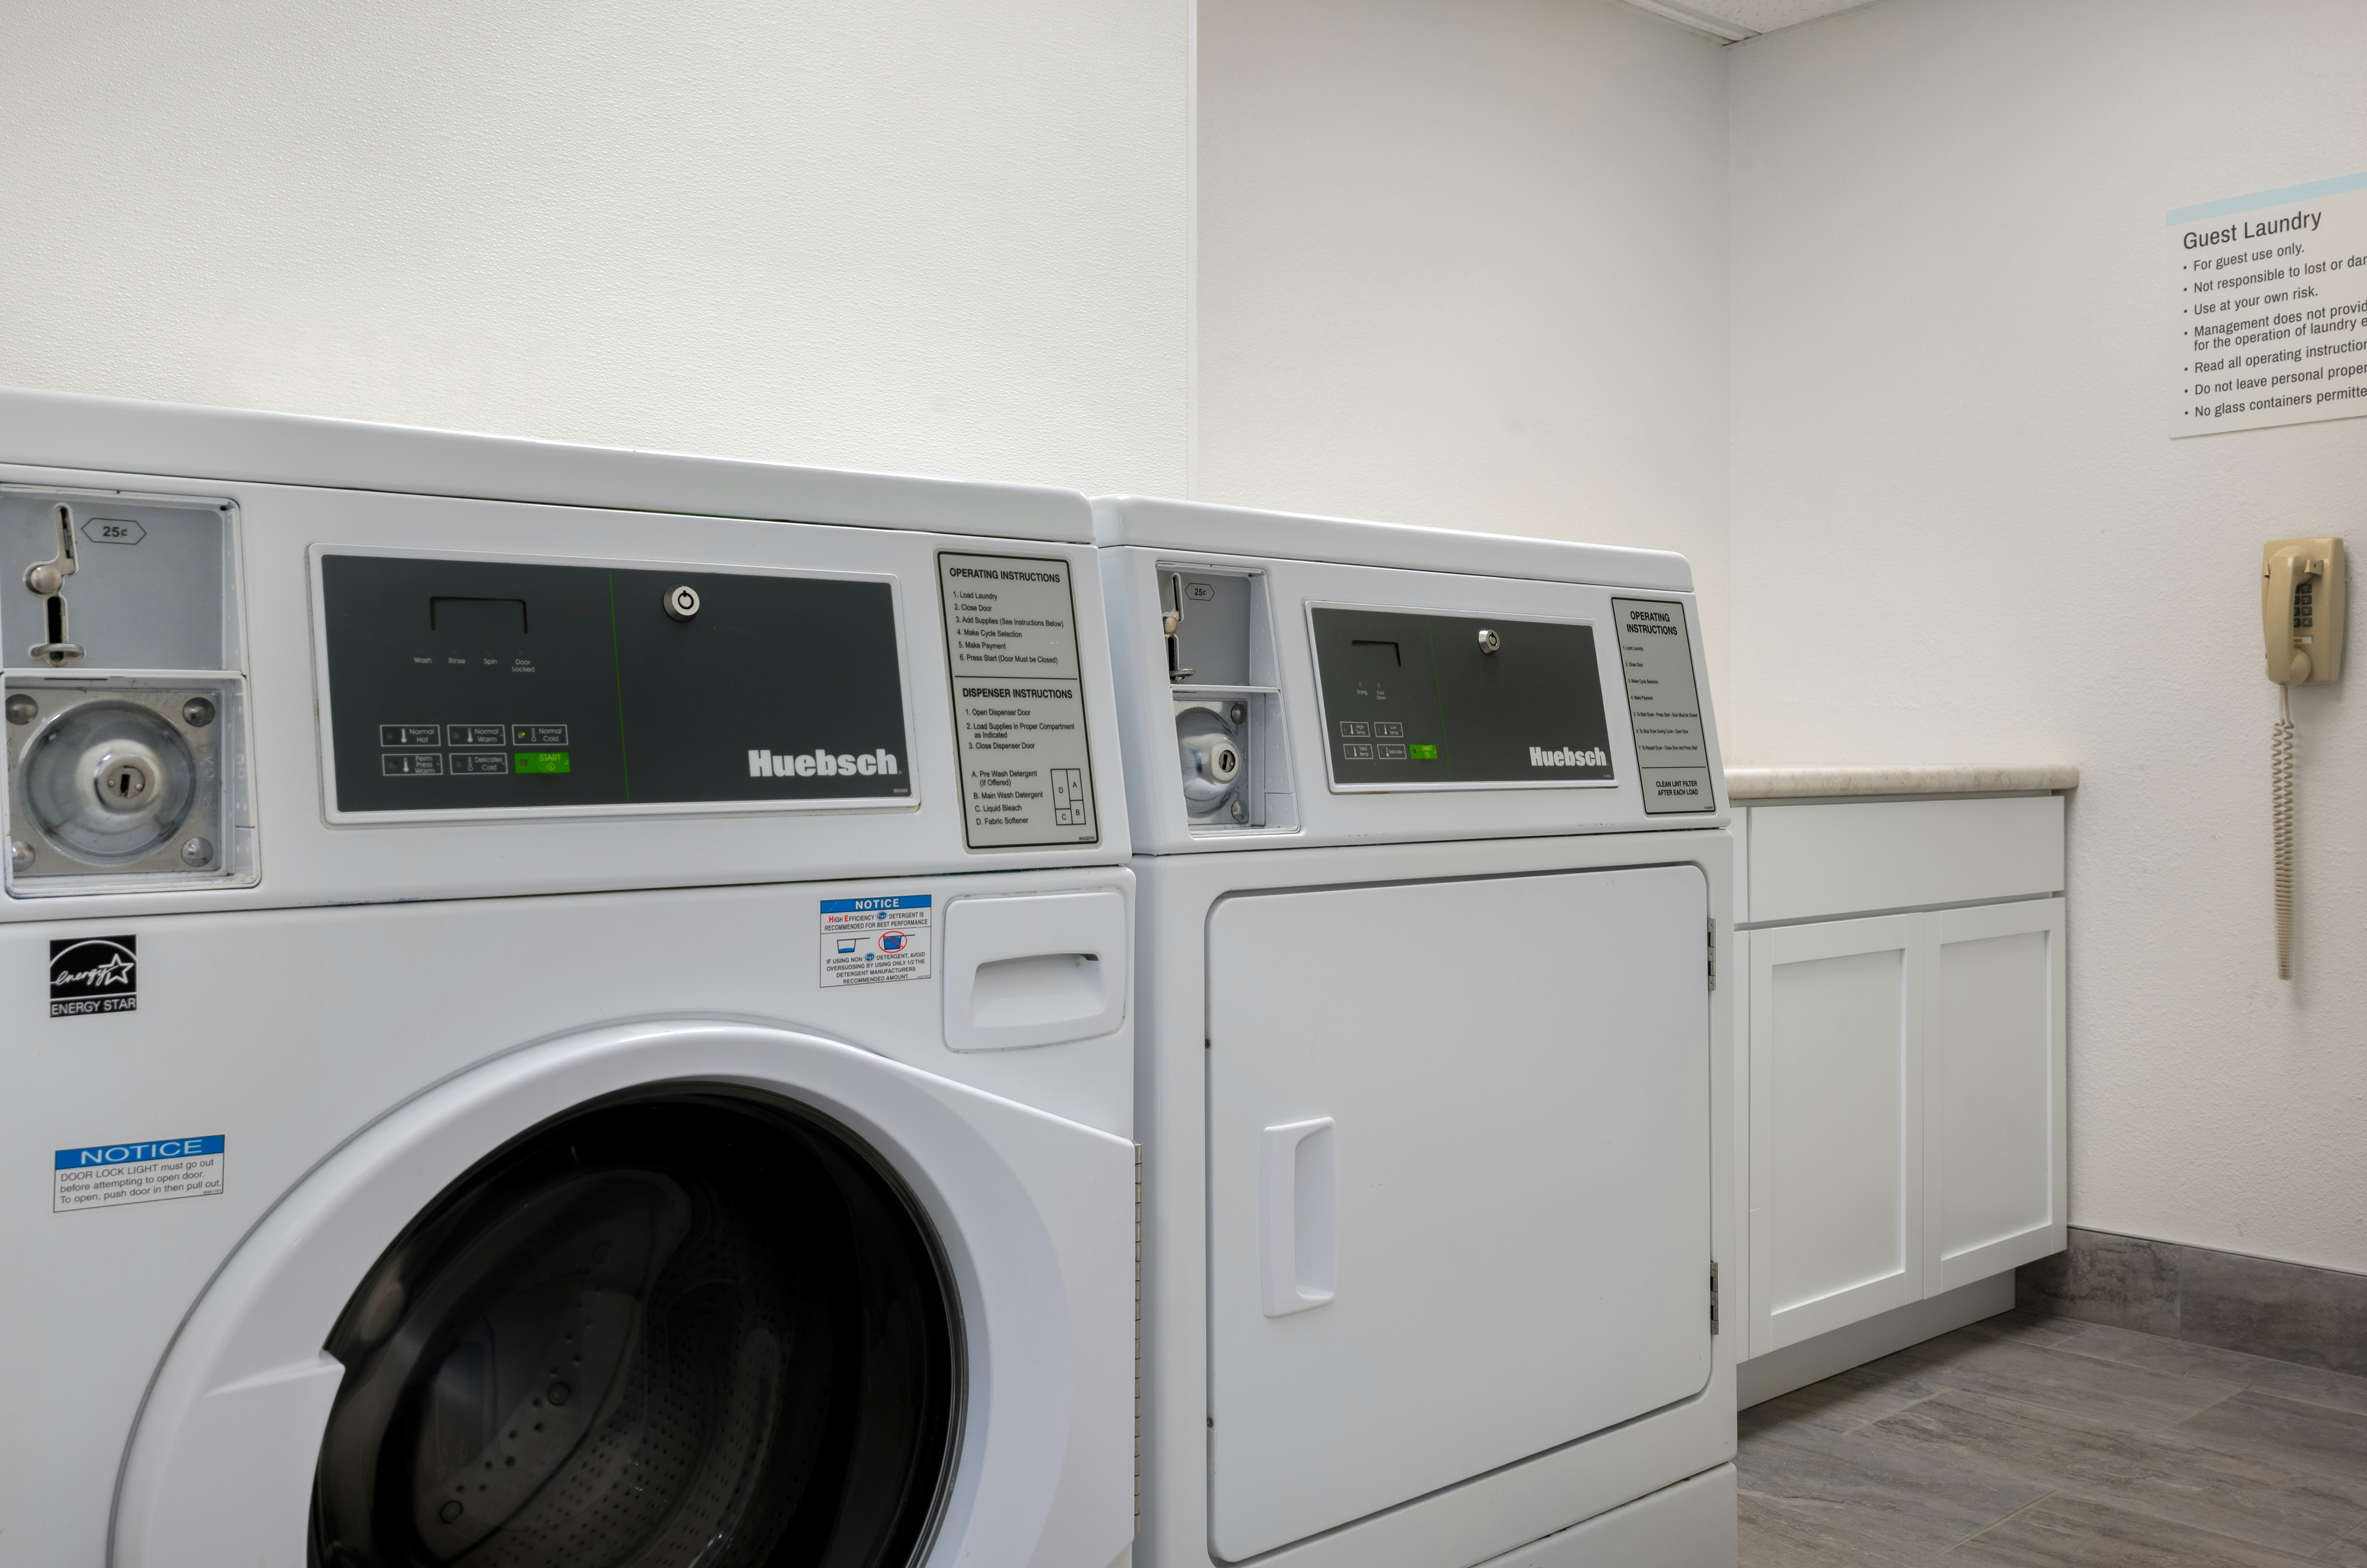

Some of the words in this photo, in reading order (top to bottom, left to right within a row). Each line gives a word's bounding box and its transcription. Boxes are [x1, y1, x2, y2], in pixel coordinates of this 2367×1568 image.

[2184, 225, 2237, 249] Guest
[2245, 212, 2321, 239] Laundry
[2194, 260, 2212, 271] For
[2216, 252, 2247, 268] guest
[2252, 249, 2272, 261] use
[2277, 243, 2304, 256] only.
[2195, 280, 2213, 293] Not
[2218, 269, 2284, 289] responsible
[2289, 266, 2300, 277] to
[2305, 261, 2326, 275] lost
[2331, 260, 2343, 270] or
[2195, 304, 2216, 315] Use
[2220, 299, 2230, 311] at
[2235, 297, 2260, 311] your
[2265, 292, 2288, 304] own
[2294, 287, 2318, 299] risk.
[2195, 316, 2269, 337] Management
[2274, 313, 2302, 325] does
[2307, 307, 2326, 320] not
[2194, 340, 2210, 351] for
[2213, 336, 2230, 348] the
[2236, 329, 2290, 346] operation
[2295, 325, 2307, 336] of
[2311, 319, 2357, 334] laundry
[2195, 358, 2224, 373] Read
[2229, 356, 2241, 369] all
[2246, 349, 2302, 367] operating
[2195, 384, 2210, 395] Do
[2215, 380, 2232, 392] not
[2237, 378, 2267, 389] leave
[2272, 368, 2323, 387] personal
[2196, 406, 2211, 417] No
[2215, 403, 2245, 416] glass
[2250, 395, 2312, 410] containers
[103, 526, 127, 537] 25¢
[950, 568, 999, 579] OPERATING
[1001, 571, 1060, 583] INSTRUCTIONS
[975, 592, 997, 601] Laundry
[975, 617, 999, 625] Supplies
[1045, 620, 1064, 629] Below)
[1630, 611, 1670, 622] OPERATING
[1626, 624, 1677, 635] INSTRUCTIONS
[963, 688, 1011, 698] DISPENSER
[1013, 689, 1072, 699] INSTRUCTIONS
[989, 723, 1012, 731] Supplies
[1020, 723, 1038, 731] Proper
[1039, 723, 1075, 731] Compartment
[748, 749, 898, 777] Huebsch
[1529, 747, 1607, 767] Huebsch
[856, 898, 899, 909] NOTICE
[825, 923, 864, 931] RECOMMENDED
[843, 976, 885, 984] RECOMMENDED
[870, 966, 916, 975] MANUFACTURERS
[51, 1000, 101, 1015] ENERGY
[104, 998, 136, 1011] STAR
[81, 1139, 202, 1164] NOTICE
[61, 1171, 93, 1182] DOOR
[96, 1167, 125, 1178] LOCK
[128, 1164, 159, 1174] LIGHT
[161, 1162, 183, 1171] must
[186, 1162, 197, 1170] go
[200, 1159, 214, 1167] out
[60, 1184, 91, 1193] before
[93, 1178, 142, 1189] attempting
[157, 1174, 179, 1184] open
[74, 1194, 101, 1203] open,
[104, 1190, 126, 1201] push
[187, 1181, 202, 1192] pull
[205, 1179, 223, 1189] out.
